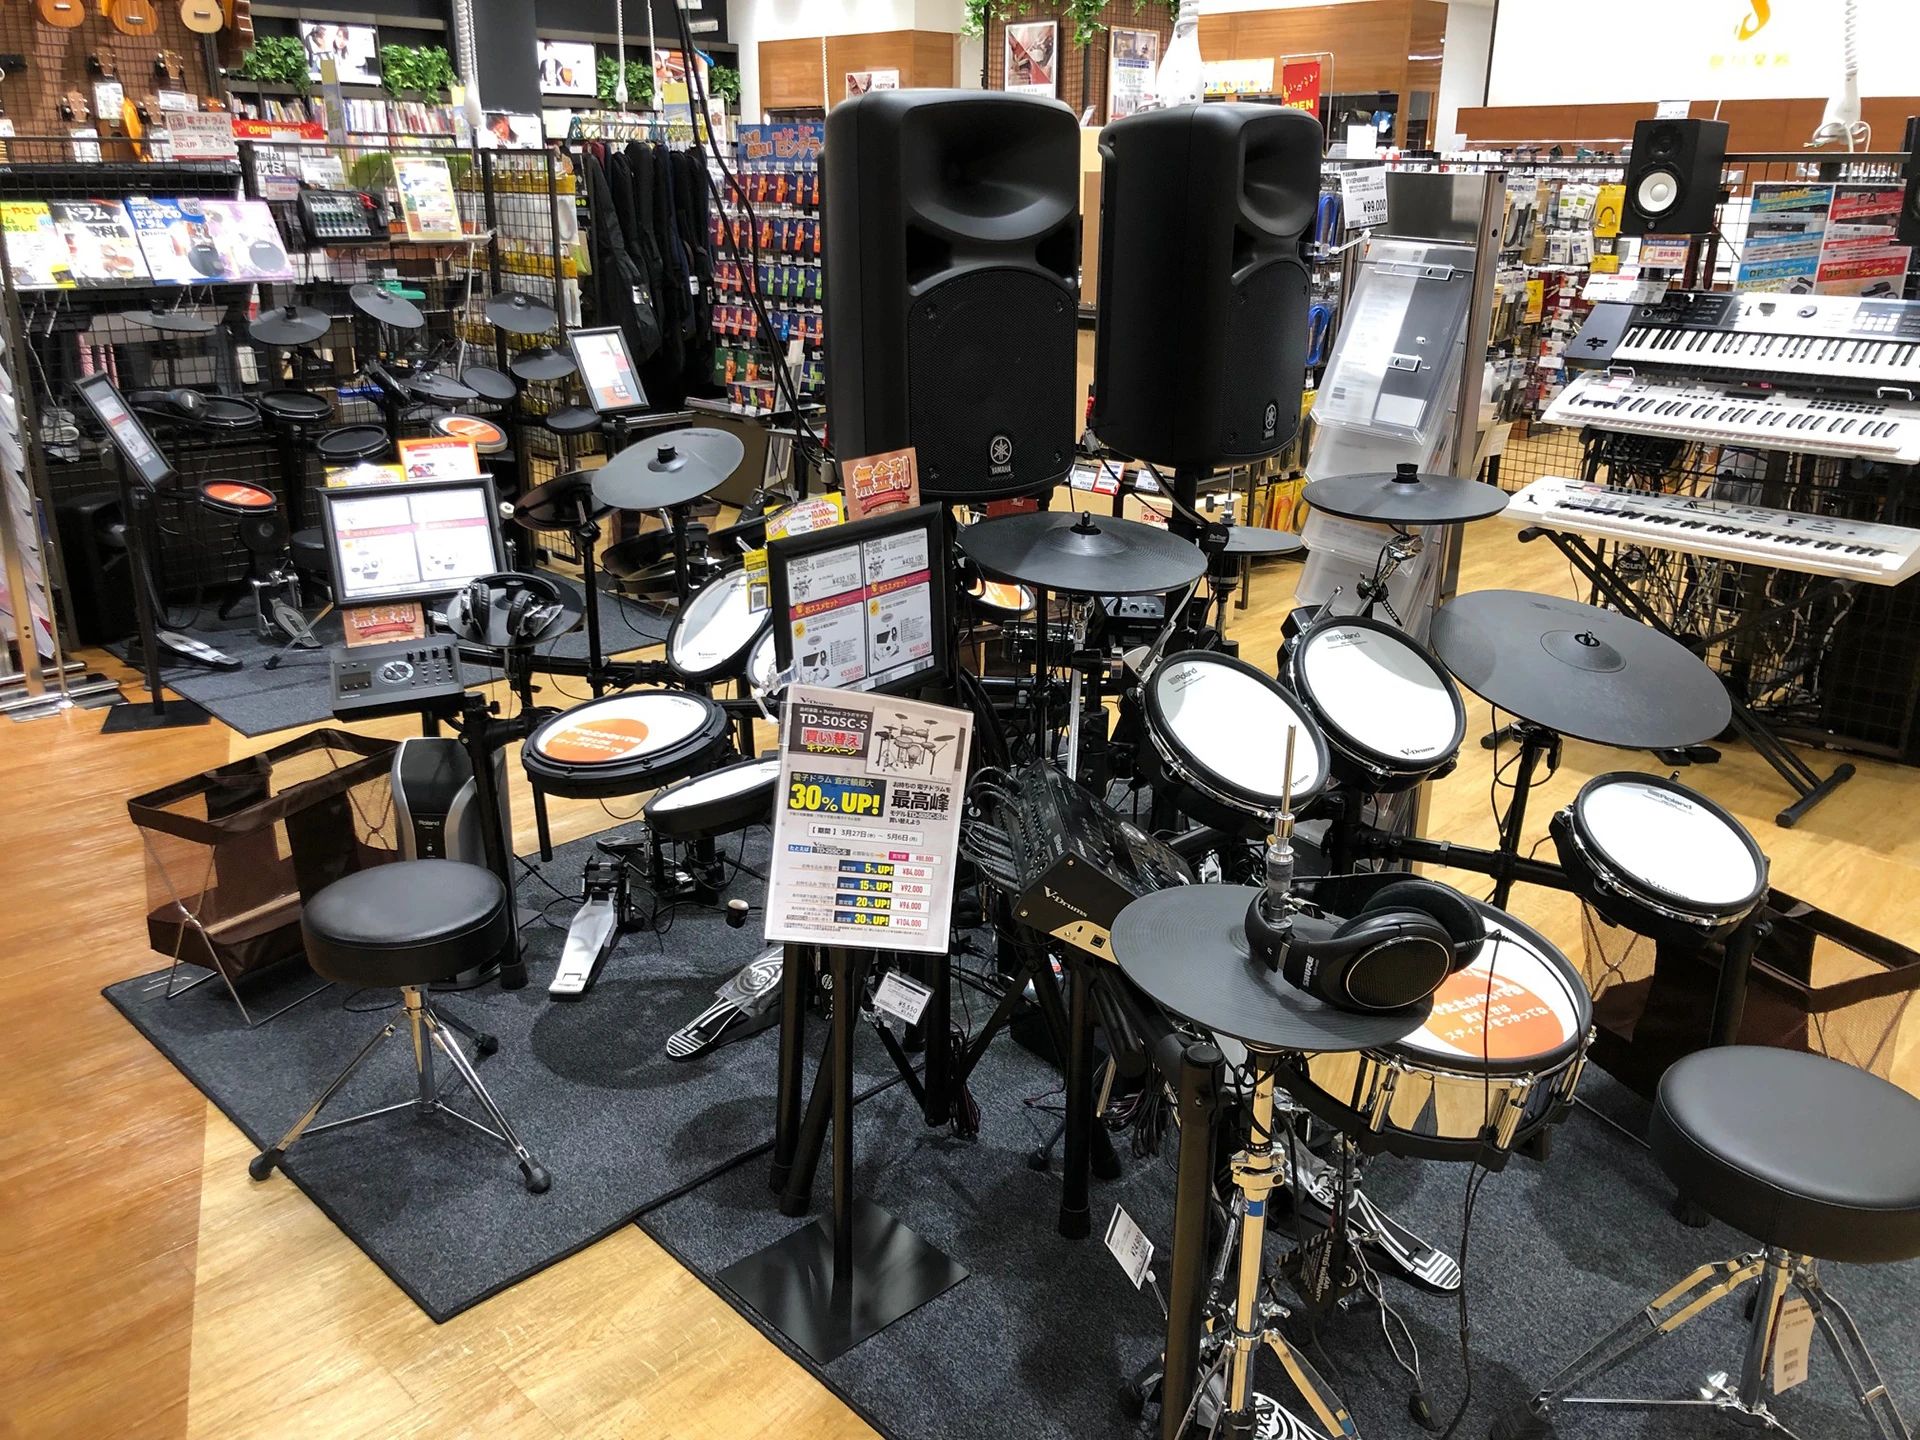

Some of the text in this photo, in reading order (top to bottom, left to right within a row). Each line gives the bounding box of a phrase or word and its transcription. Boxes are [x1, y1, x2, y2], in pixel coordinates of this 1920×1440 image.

[248, 125, 271, 135] OPEN
[1857, 193, 1877, 205] FA
[1363, 199, 1387, 212] ¥99,000
[991, 465, 1012, 475] YAMAHA
[853, 455, 911, 498] 無金利
[1335, 632, 1361, 641] Roland
[1174, 667, 1198, 681] Roland
[800, 713, 868, 730] TD-50SC-S
[804, 729, 860, 748] 買い替え
[806, 743, 857, 756] キャンペーン
[1401, 746, 1435, 756] V-Drums
[793, 773, 832, 784] 電子ドラム
[893, 781, 951, 793] お持ちの 電子ドラムを
[789, 783, 880, 815] 30% UP!
[890, 789, 950, 812] 最高峰
[1660, 793, 1692, 810] Roland
[889, 817, 921, 826] 買い替えよう
[878, 865, 893, 875] UP!
[902, 868, 925, 877] ¥84,000
[876, 882, 892, 892] UP!
[901, 884, 923, 894] ¥92,000
[874, 899, 890, 909] UP!
[899, 901, 921, 911] ¥96,000
[1044, 885, 1088, 918] V-Drums
[872, 916, 889, 926] UP!
[896, 918, 921, 928] ¥104,000
[1302, 955, 1314, 987] SHURE
